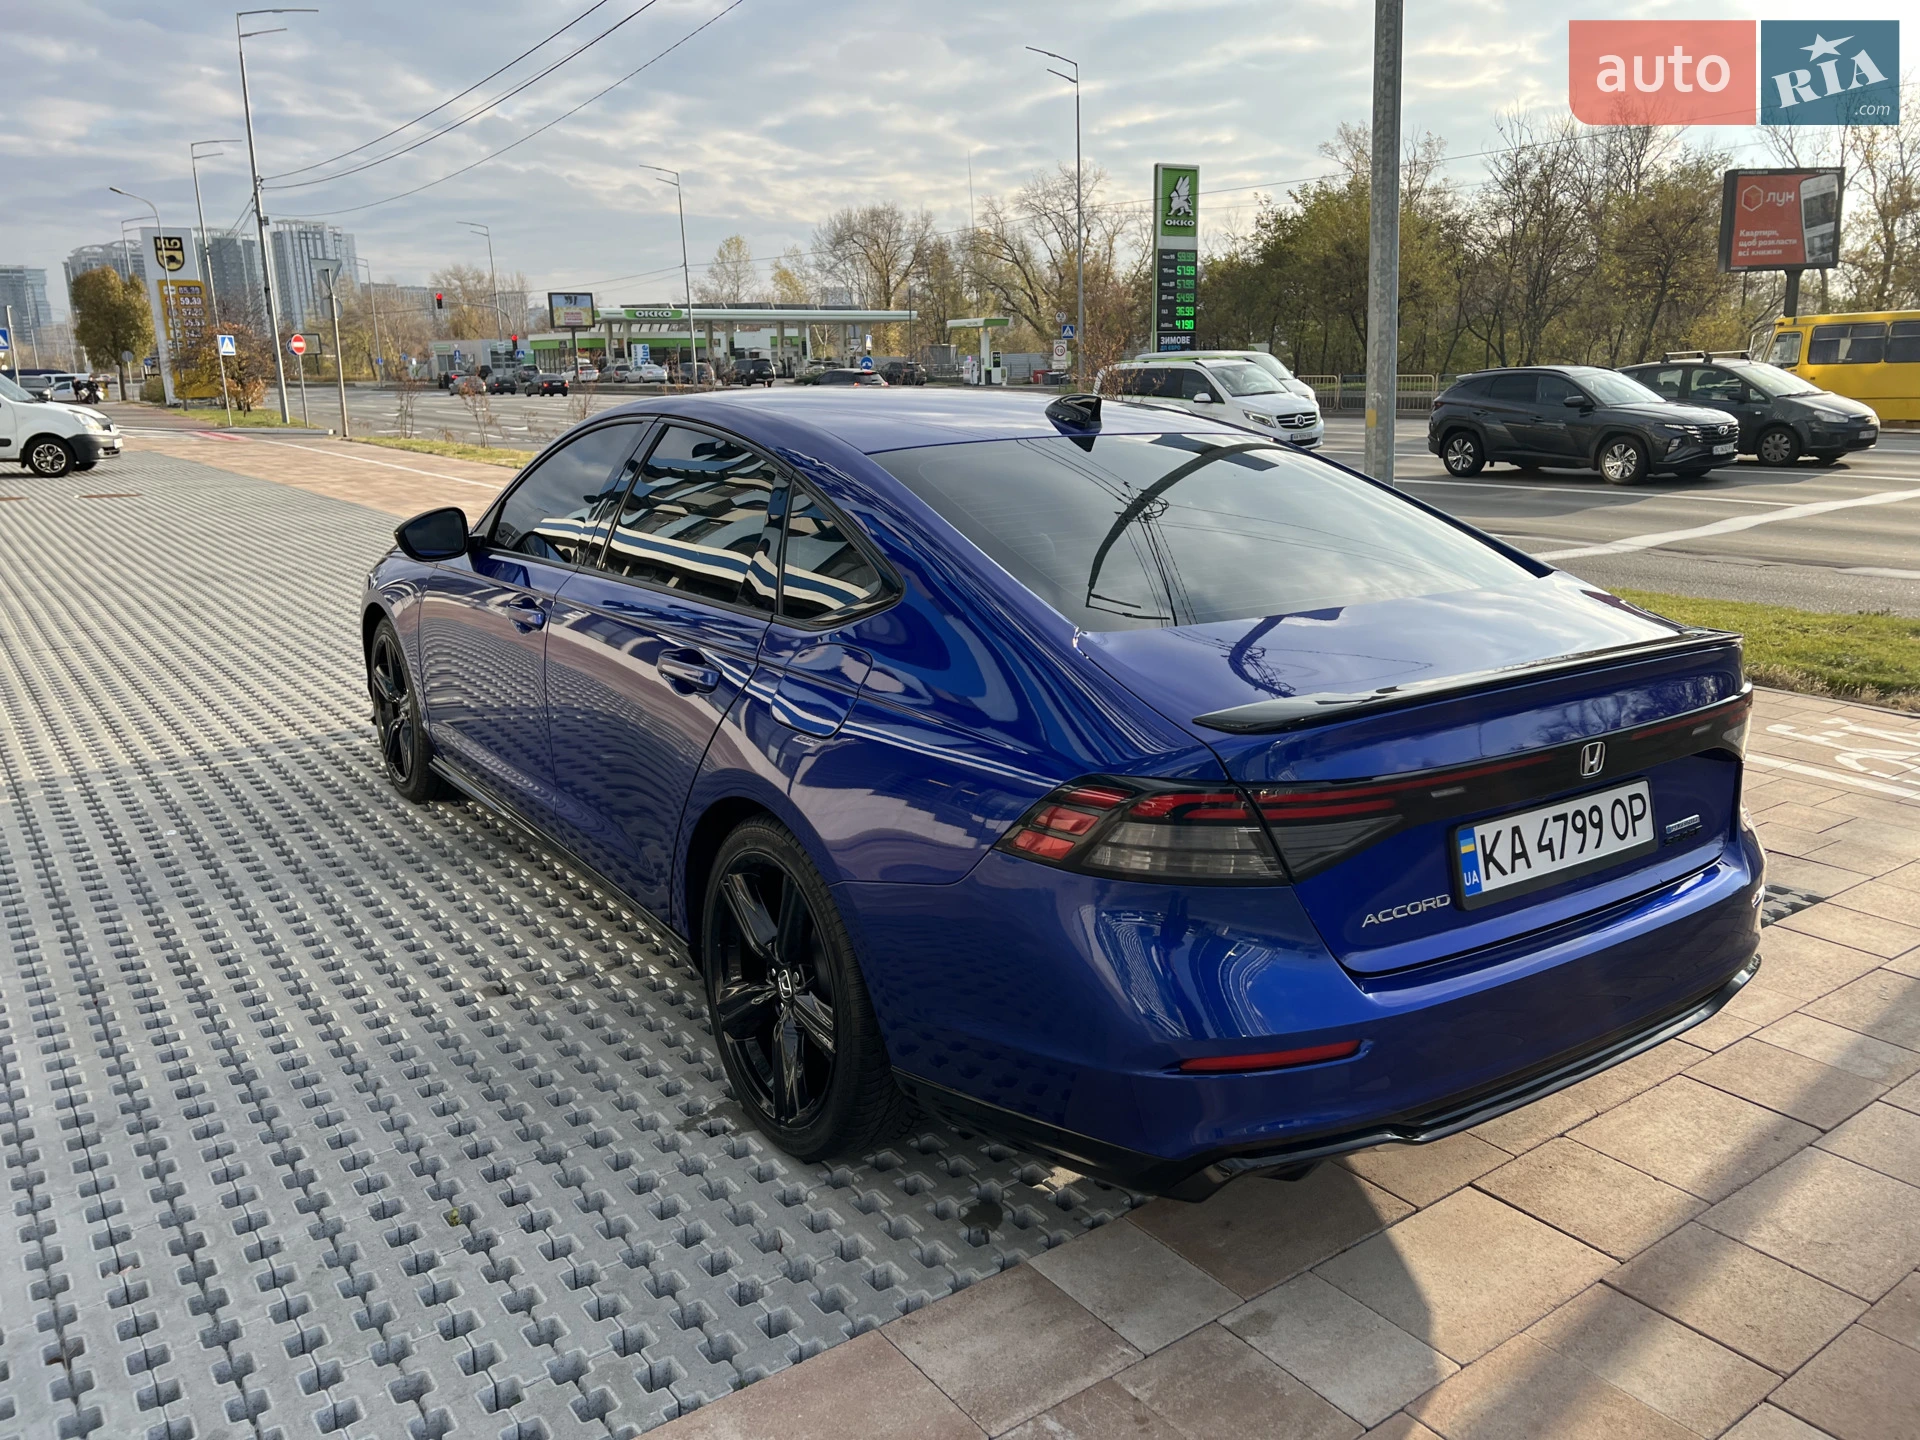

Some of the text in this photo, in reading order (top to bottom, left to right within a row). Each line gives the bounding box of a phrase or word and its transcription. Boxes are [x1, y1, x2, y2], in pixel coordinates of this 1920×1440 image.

[1160, 336, 1191, 345] ЗИМОВЕ
[1481, 793, 1647, 881] KA 4799 OP
[1464, 871, 1480, 886] UA
[1361, 894, 1451, 928] ACCORD
